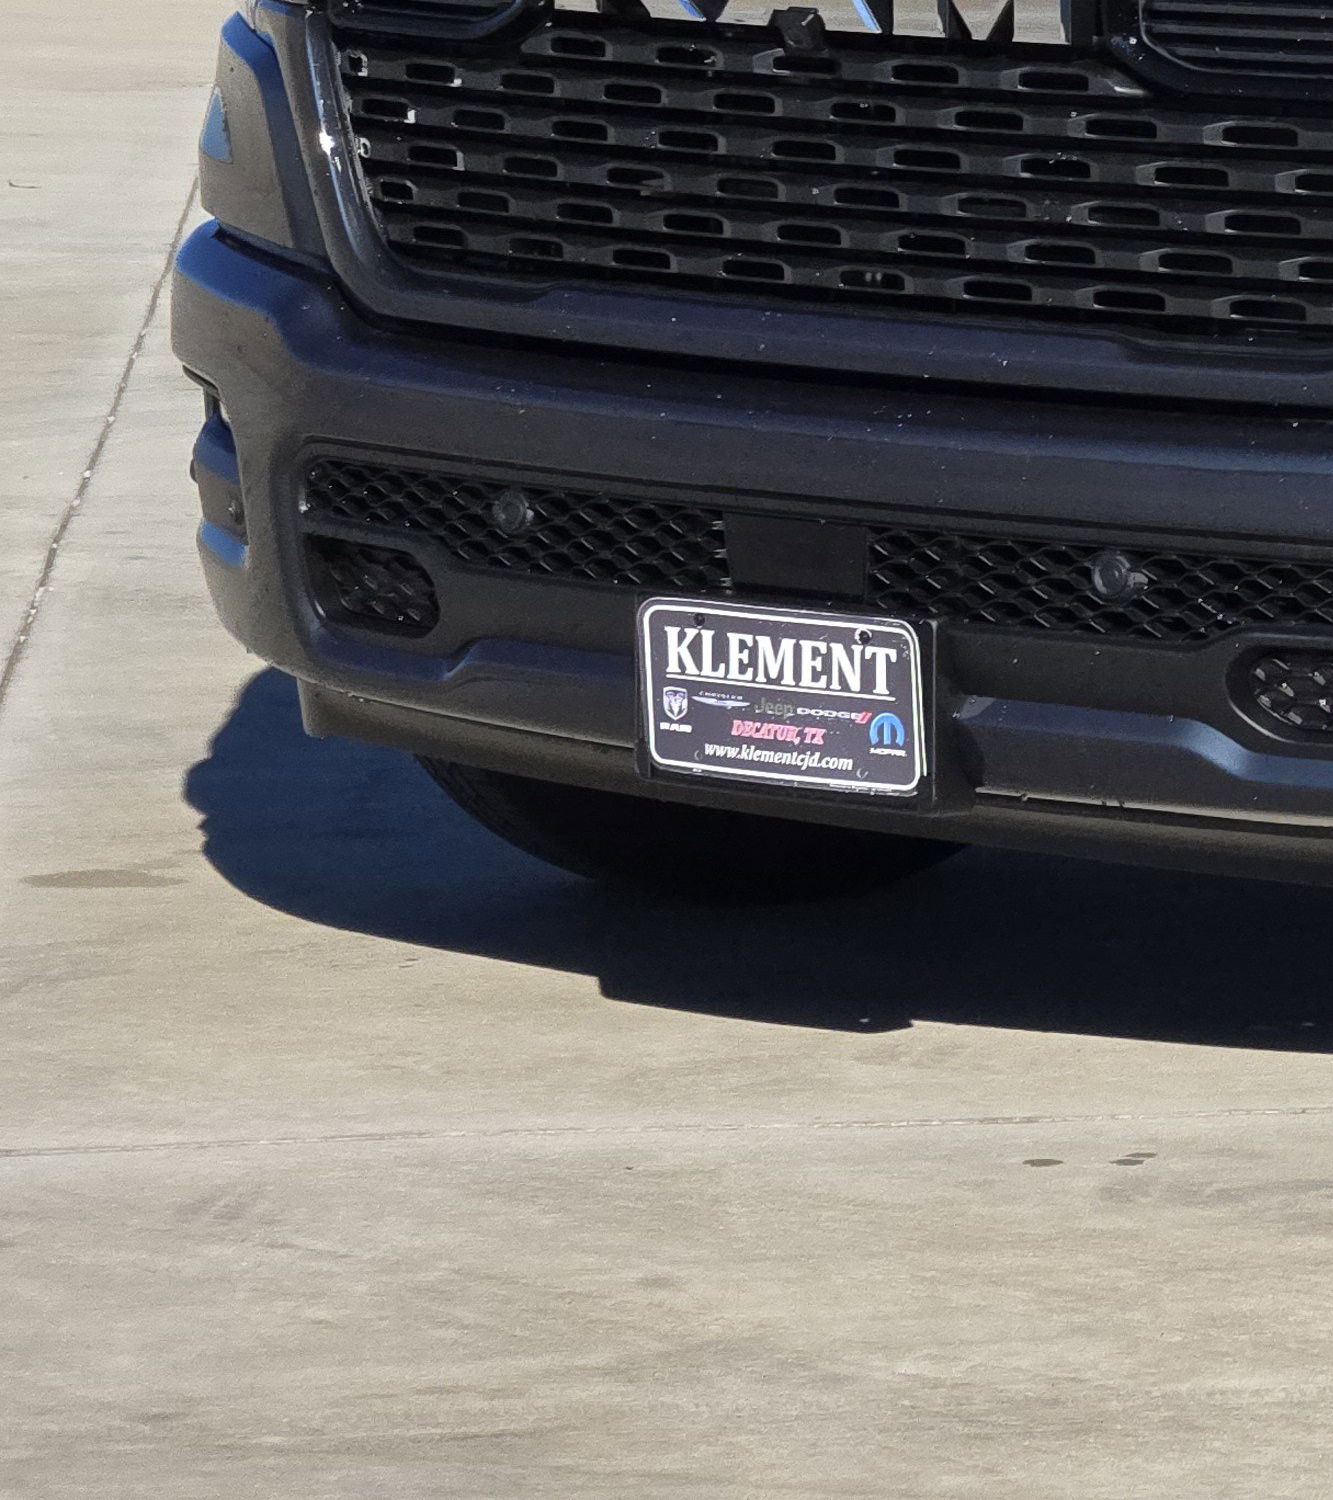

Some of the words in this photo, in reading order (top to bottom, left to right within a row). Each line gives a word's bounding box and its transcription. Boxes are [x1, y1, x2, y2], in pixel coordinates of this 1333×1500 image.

[664, 626, 897, 695] KLEMENT
[754, 697, 795, 719] Jeep
[796, 707, 861, 720] DODGE
[731, 719, 801, 745] DECATUR,
[803, 727, 826, 745] TX
[704, 743, 853, 771] www.klementcjd.com
